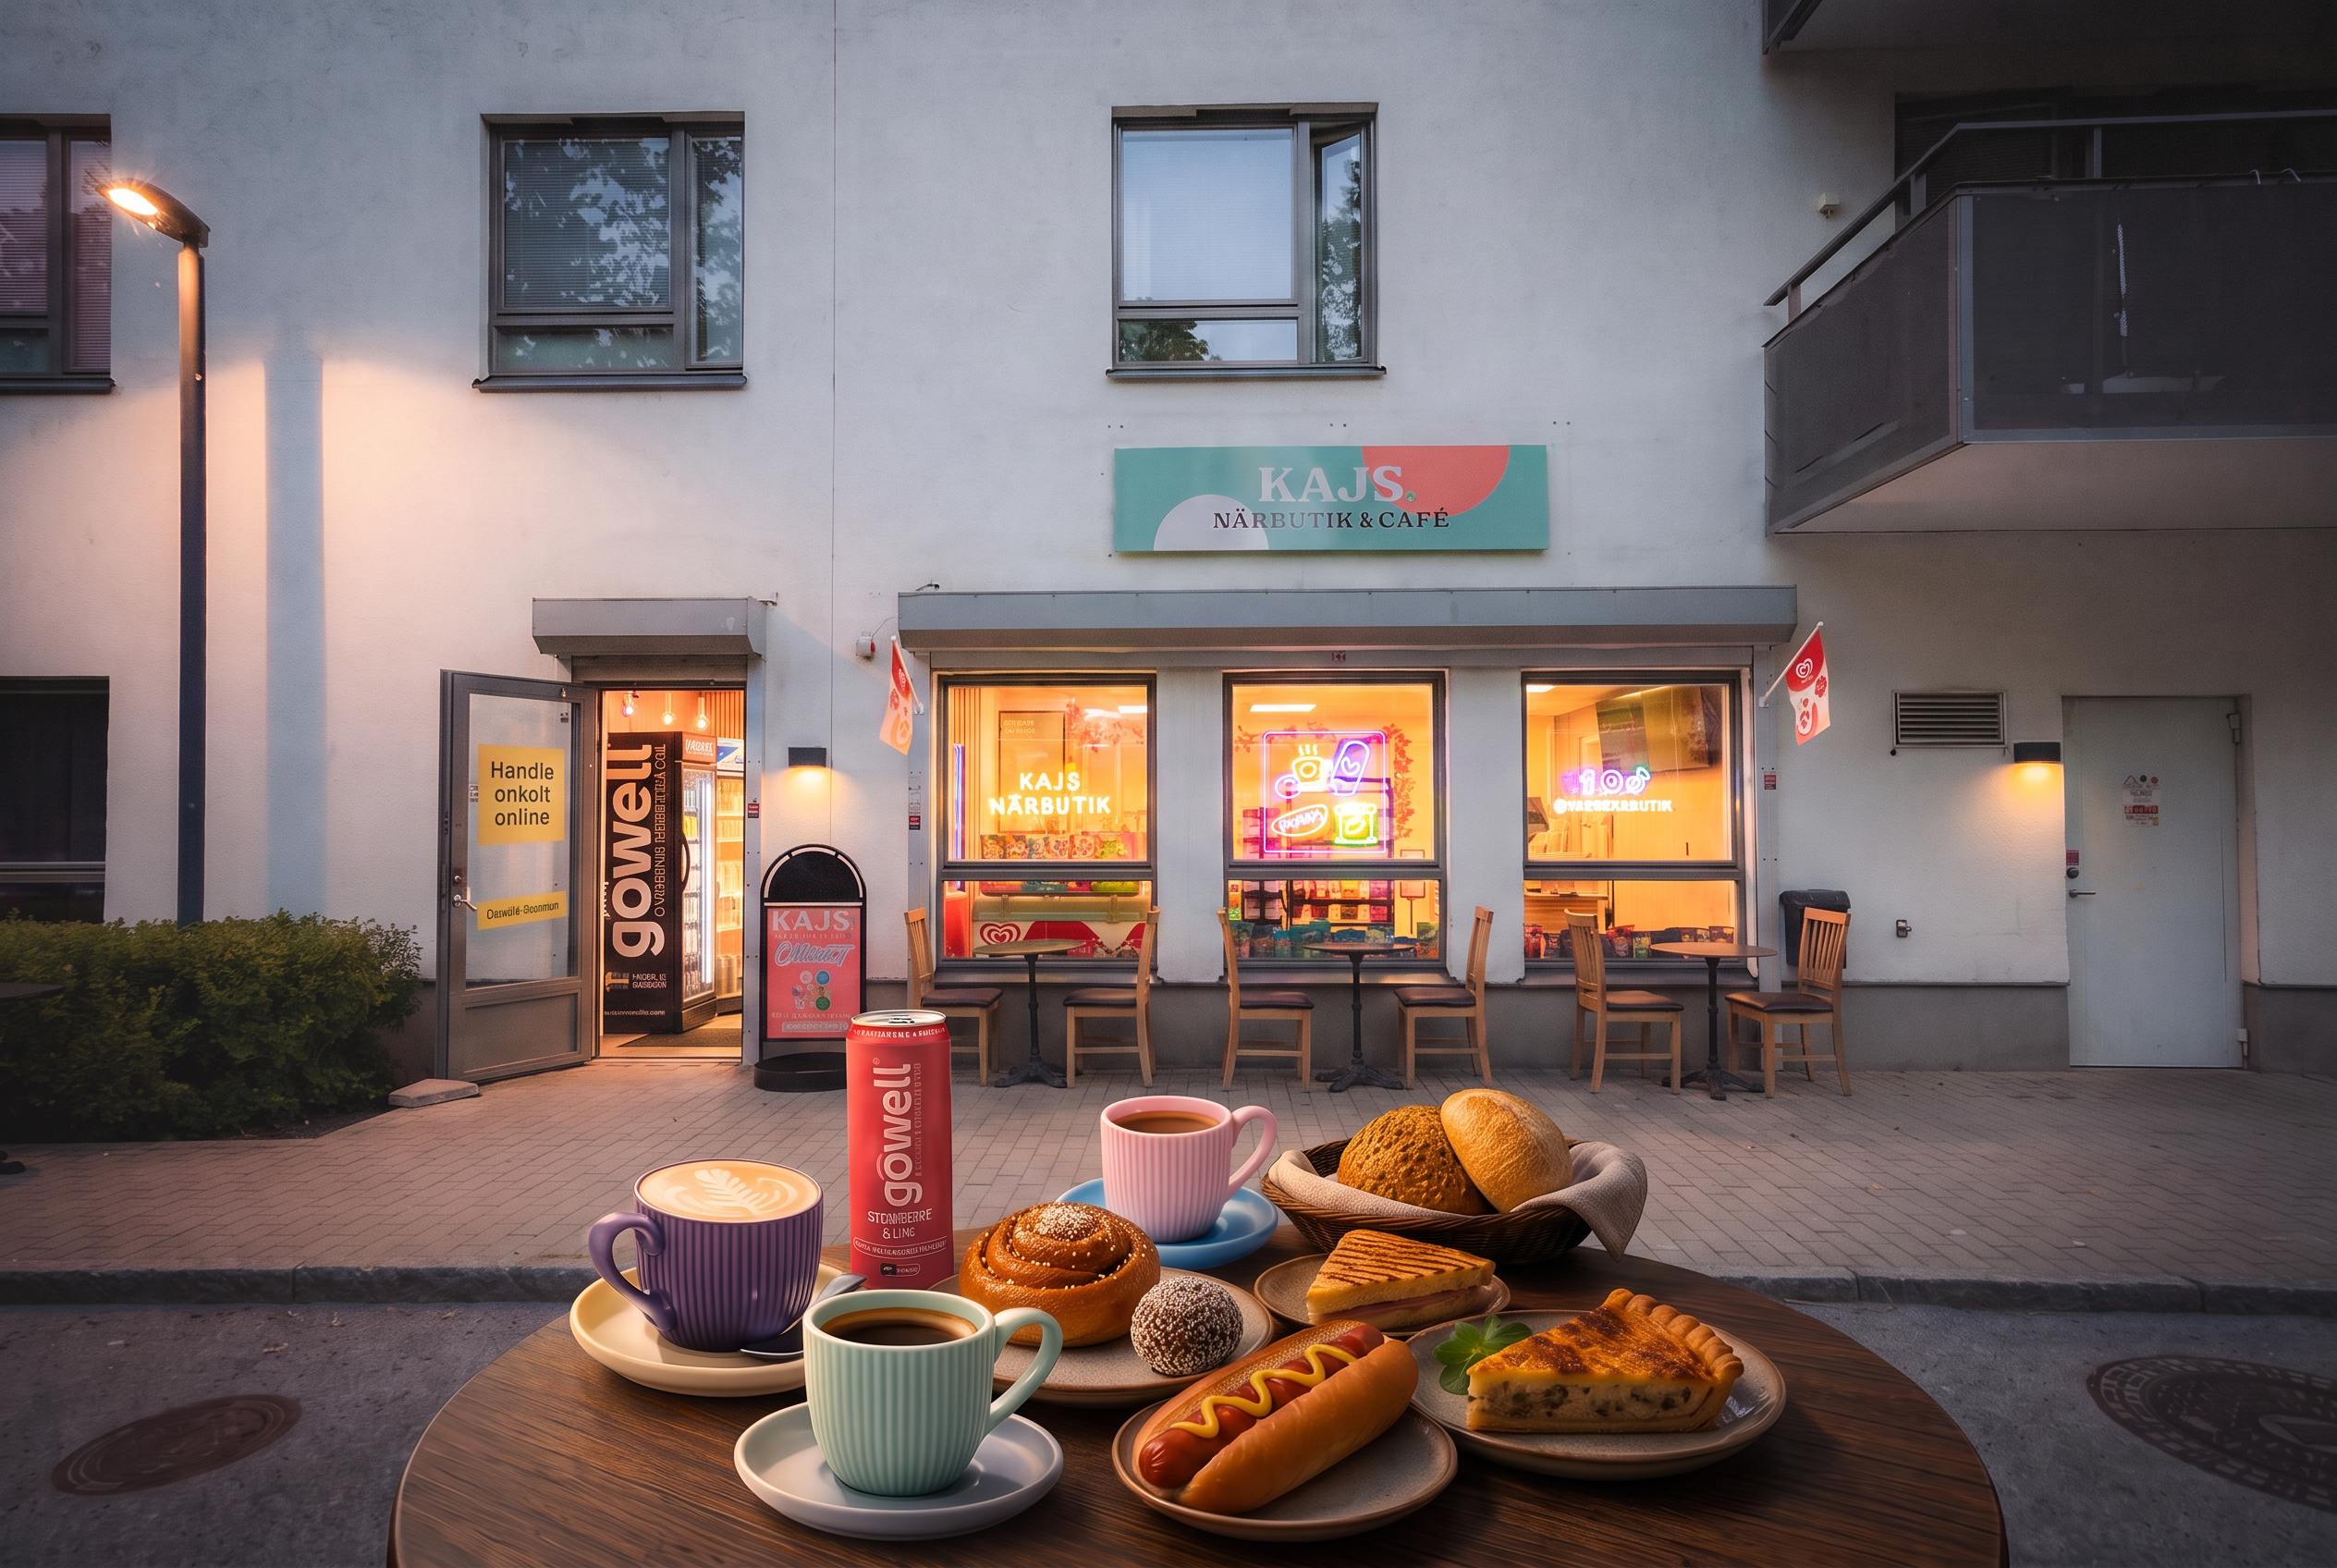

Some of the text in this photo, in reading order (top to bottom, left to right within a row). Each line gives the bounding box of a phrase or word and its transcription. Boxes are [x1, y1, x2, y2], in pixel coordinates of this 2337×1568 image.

[1212, 507, 1450, 529] NÄRBUTIK & CAFÉ
[491, 761, 554, 780] Handle
[1020, 772, 1081, 791] KAJS
[495, 785, 551, 802] onkolt
[495, 807, 550, 826] online
[606, 744, 665, 958] gowell
[882, 1227, 891, 1239] &
